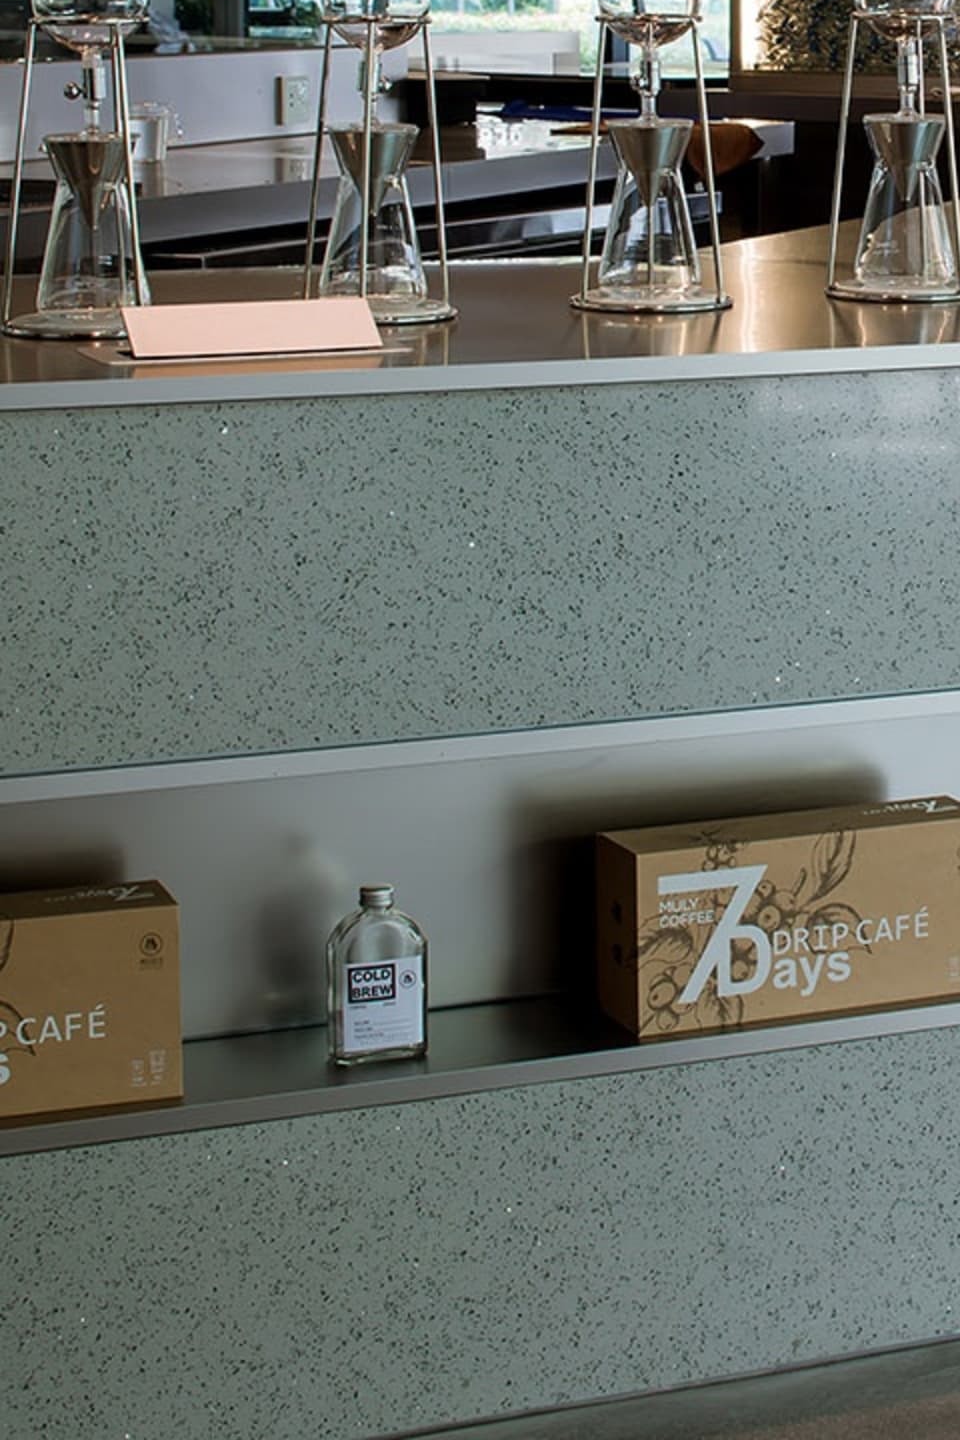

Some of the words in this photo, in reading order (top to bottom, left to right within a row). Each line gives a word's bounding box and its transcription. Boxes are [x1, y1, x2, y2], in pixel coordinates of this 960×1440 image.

[659, 897, 699, 913] MULY
[659, 909, 714, 929] COFFEE
[773, 923, 849, 956] DRIP
[855, 905, 929, 946] CAFÉ
[352, 968, 391, 983] COLD
[351, 983, 391, 999] BREW
[16, 1003, 106, 1046] CAFÉ
